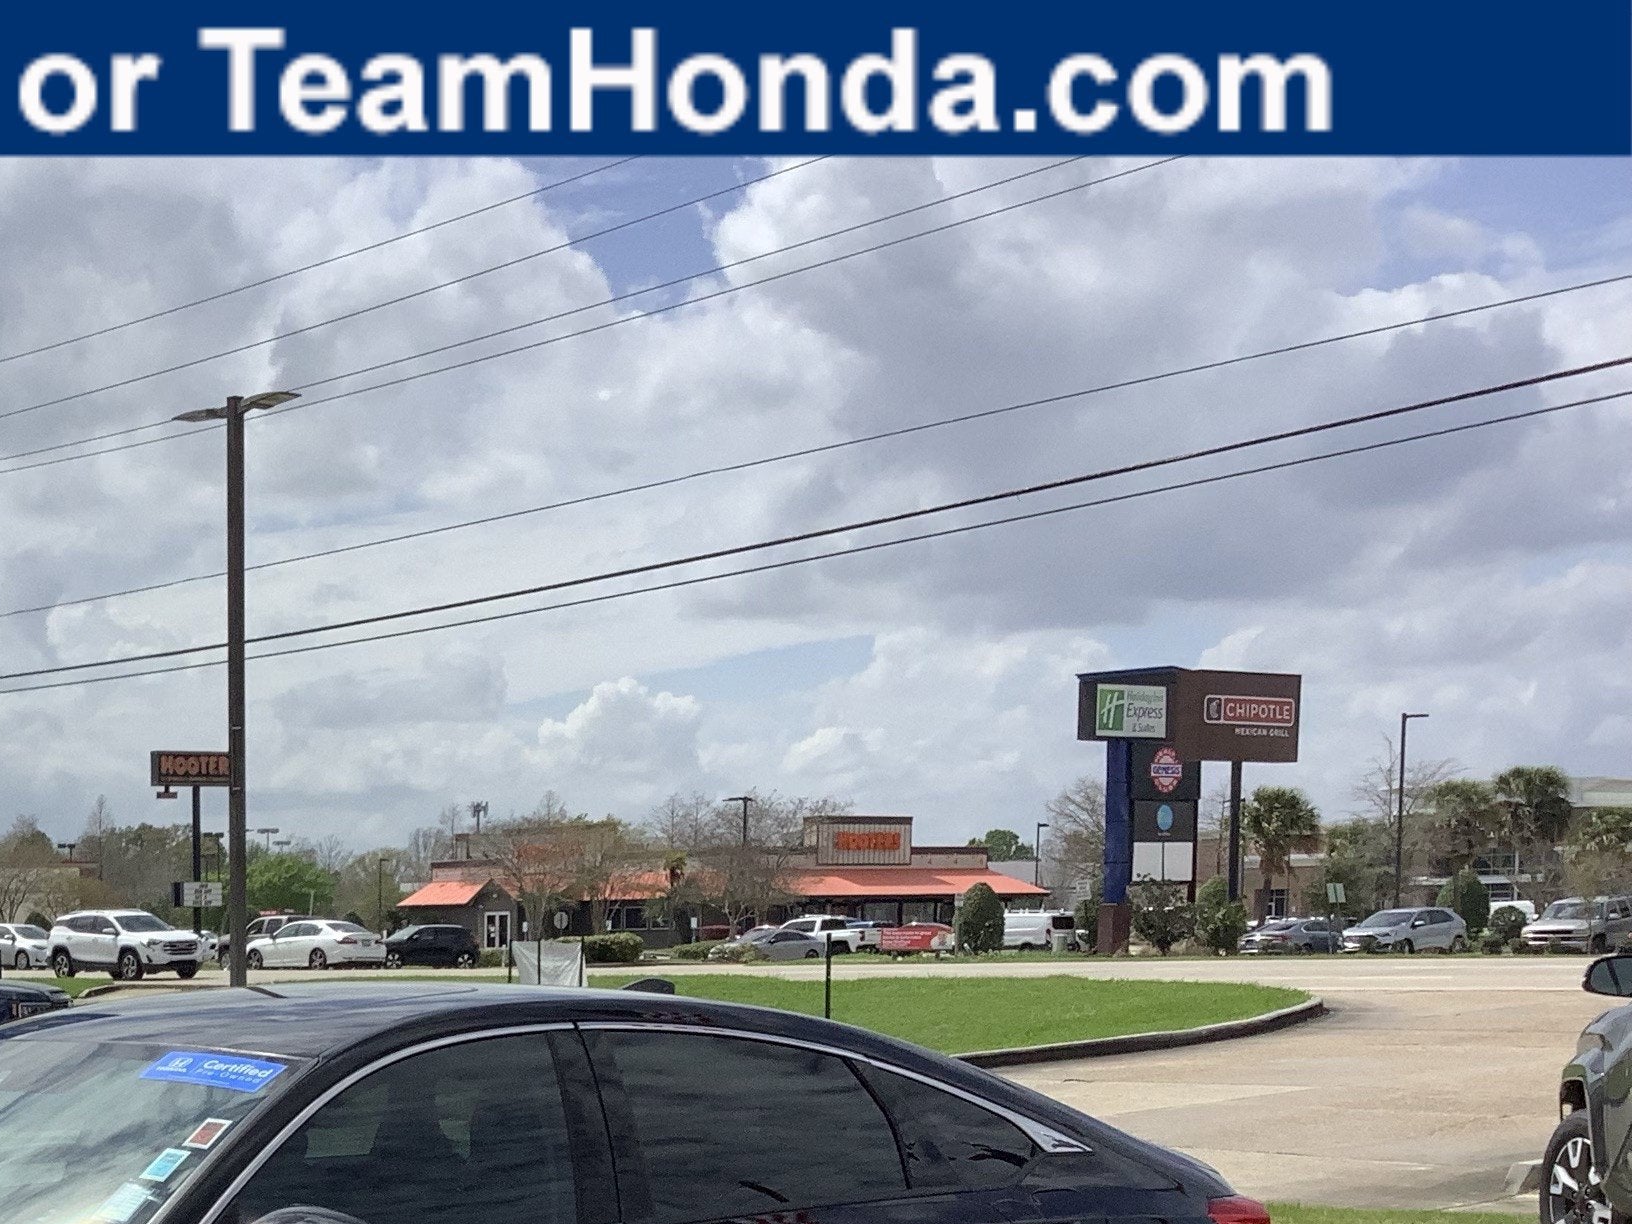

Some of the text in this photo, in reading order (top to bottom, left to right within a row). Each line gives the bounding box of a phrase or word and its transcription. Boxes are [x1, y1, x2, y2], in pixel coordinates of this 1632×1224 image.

[1126, 702, 1163, 722] Express
[1226, 703, 1291, 720] CHIPOTLE
[160, 755, 230, 776] HOOTER
[203, 1060, 274, 1078] Certified
